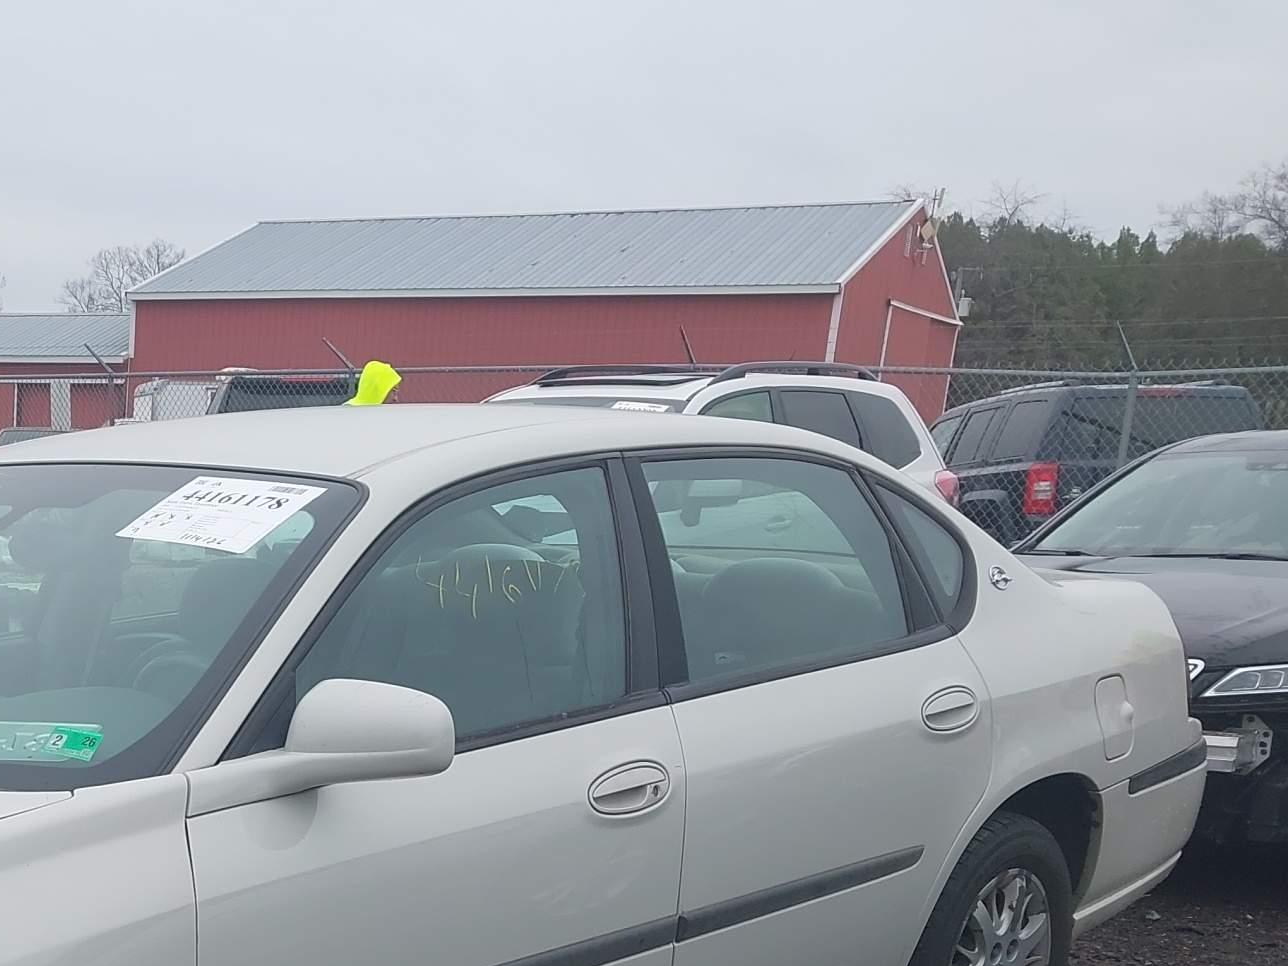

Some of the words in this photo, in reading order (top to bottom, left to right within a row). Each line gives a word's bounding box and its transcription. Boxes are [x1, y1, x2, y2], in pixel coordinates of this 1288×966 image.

[181, 489, 290, 510] 44161178
[51, 734, 64, 747] 2
[80, 736, 98, 748] 26
